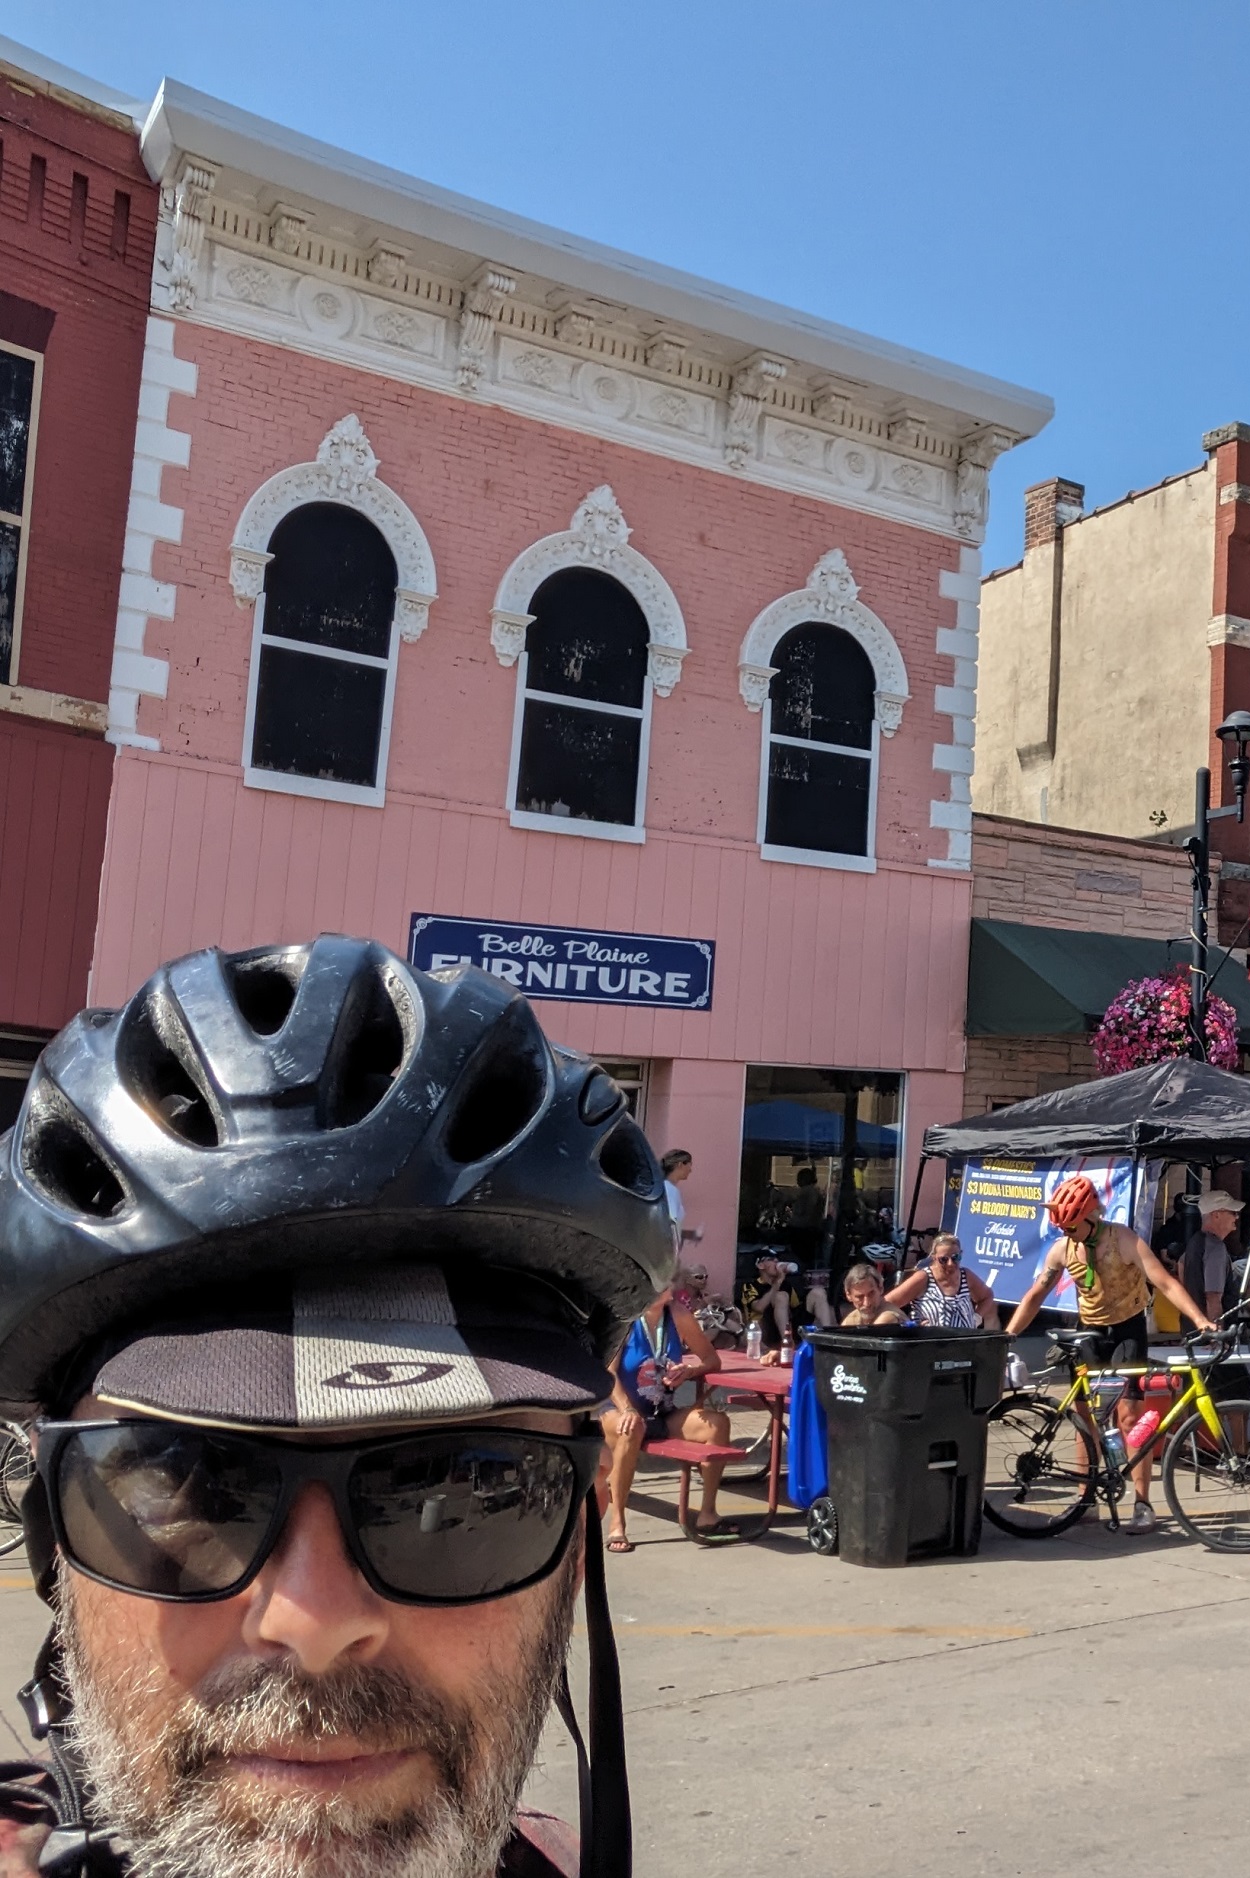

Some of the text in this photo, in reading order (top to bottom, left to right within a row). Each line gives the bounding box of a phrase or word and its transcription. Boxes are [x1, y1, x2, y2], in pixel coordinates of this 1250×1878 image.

[478, 933, 650, 965] Belle Plaine
[966, 1180, 979, 1195] $3
[1001, 1183, 1042, 1200] LEMONADES
[970, 1199, 1037, 1219] $4 BLOODY MARY'S
[975, 1236, 1023, 1259] ULTRA
